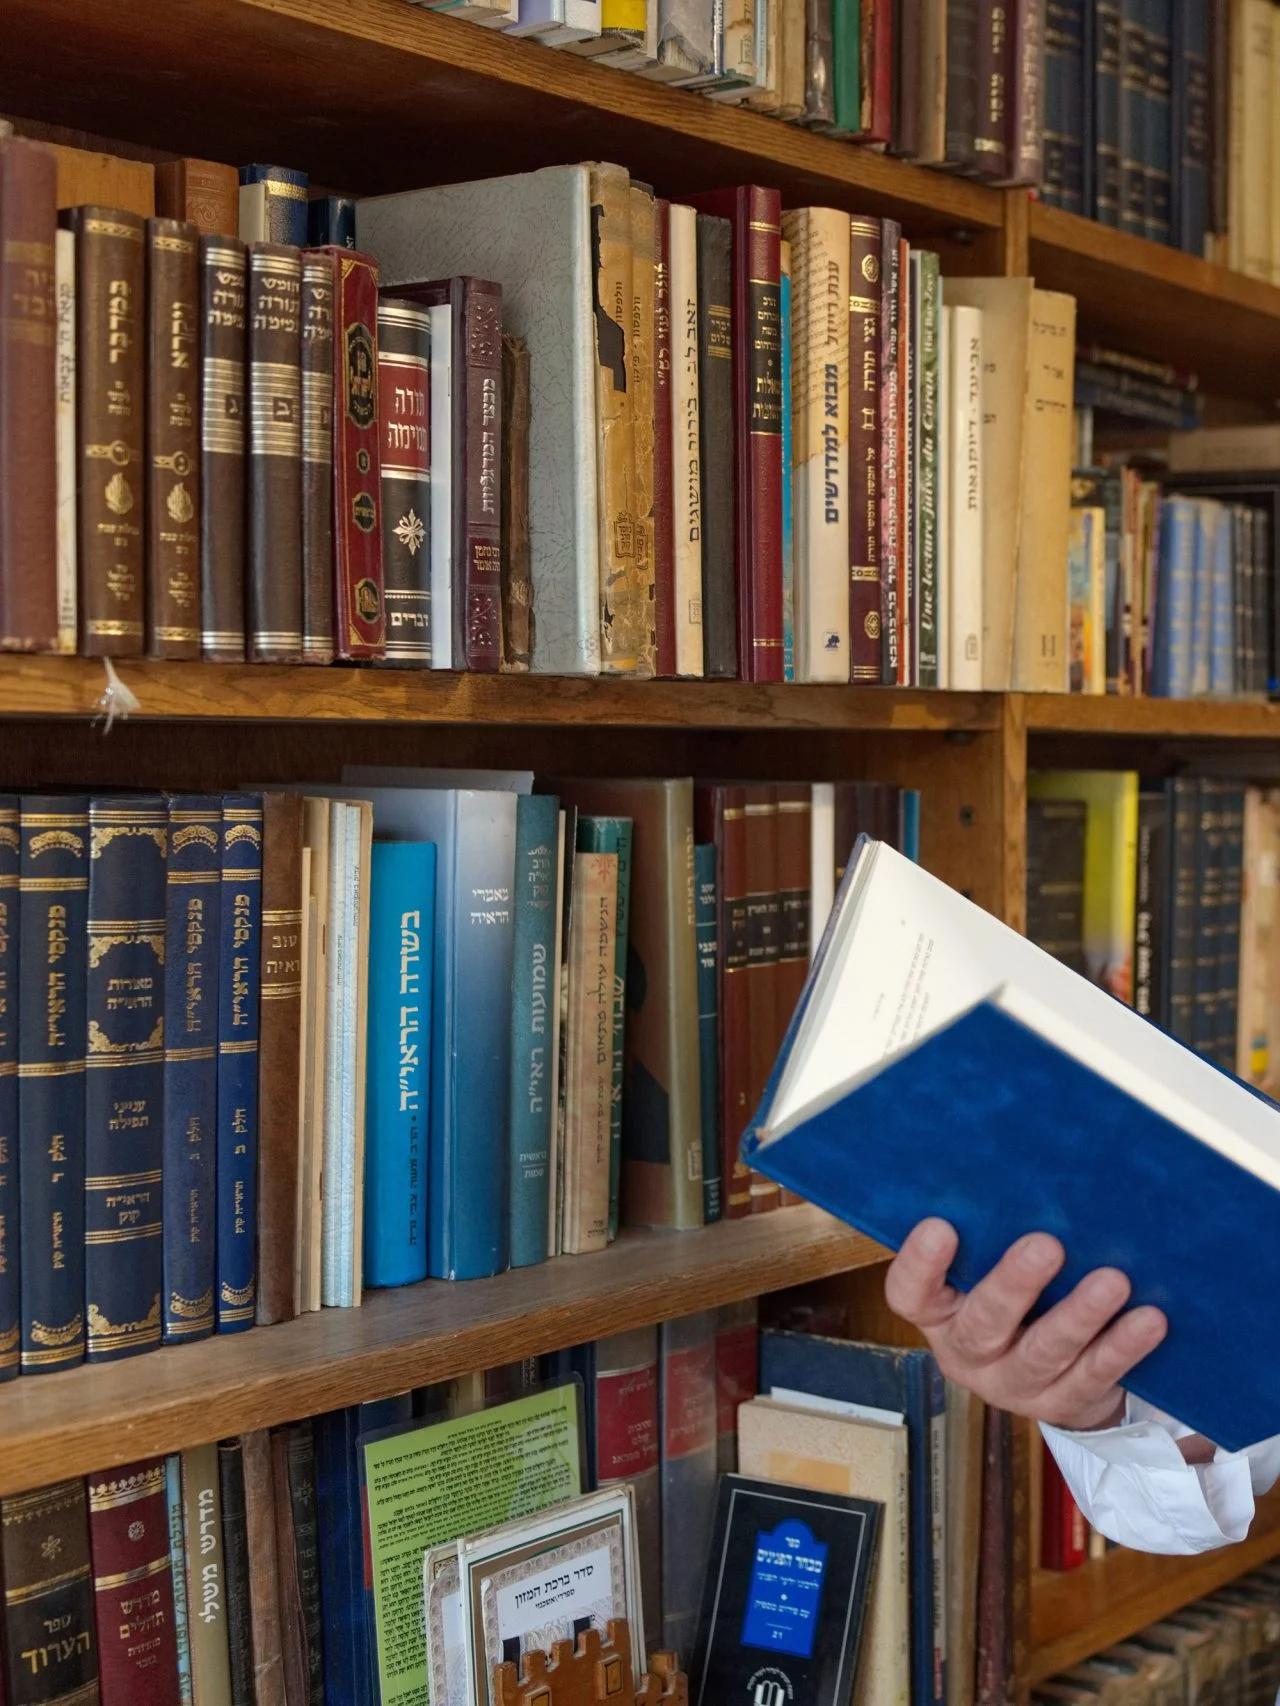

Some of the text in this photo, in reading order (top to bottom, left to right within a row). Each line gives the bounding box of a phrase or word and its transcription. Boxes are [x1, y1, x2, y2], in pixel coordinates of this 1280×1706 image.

[825, 260, 840, 297] ענת
[109, 279, 132, 364] במדבר
[632, 296, 641, 337] וולפסון
[687, 298, 698, 339] זאב
[862, 350, 876, 392] תורה
[394, 386, 425, 415] תורה
[481, 378, 496, 425] מבצר
[388, 421, 427, 450] תמימה
[688, 397, 699, 451] בירור
[820, 363, 840, 525] מבוא למדרשים
[688, 459, 700, 543] מושגים
[920, 369, 936, 631] Une lecture juive du Coran
[390, 611, 429, 627] דברים
[471, 887, 510, 902] מאמרי
[48, 905, 69, 964] פנקסי
[186, 898, 206, 954] פנקסי
[232, 894, 253, 948] פנקסי
[470, 909, 510, 926] הראיה
[399, 910, 420, 995] בשדה
[532, 943, 547, 1035] שמועות
[592, 897, 608, 1065] הנשמה עולה פתאום
[187, 1116, 203, 1142] חלק
[232, 1108, 249, 1133] חלק
[50, 1134, 68, 1162] חלק
[409, 1126, 418, 1246] הרב משה צבי נריה
[198, 1488, 221, 1624] מדרש משלי
[515, 1565, 594, 1608] סדר ברכת המזון
[43, 1613, 72, 1633] ספר
[119, 1611, 165, 1640] תהלים
